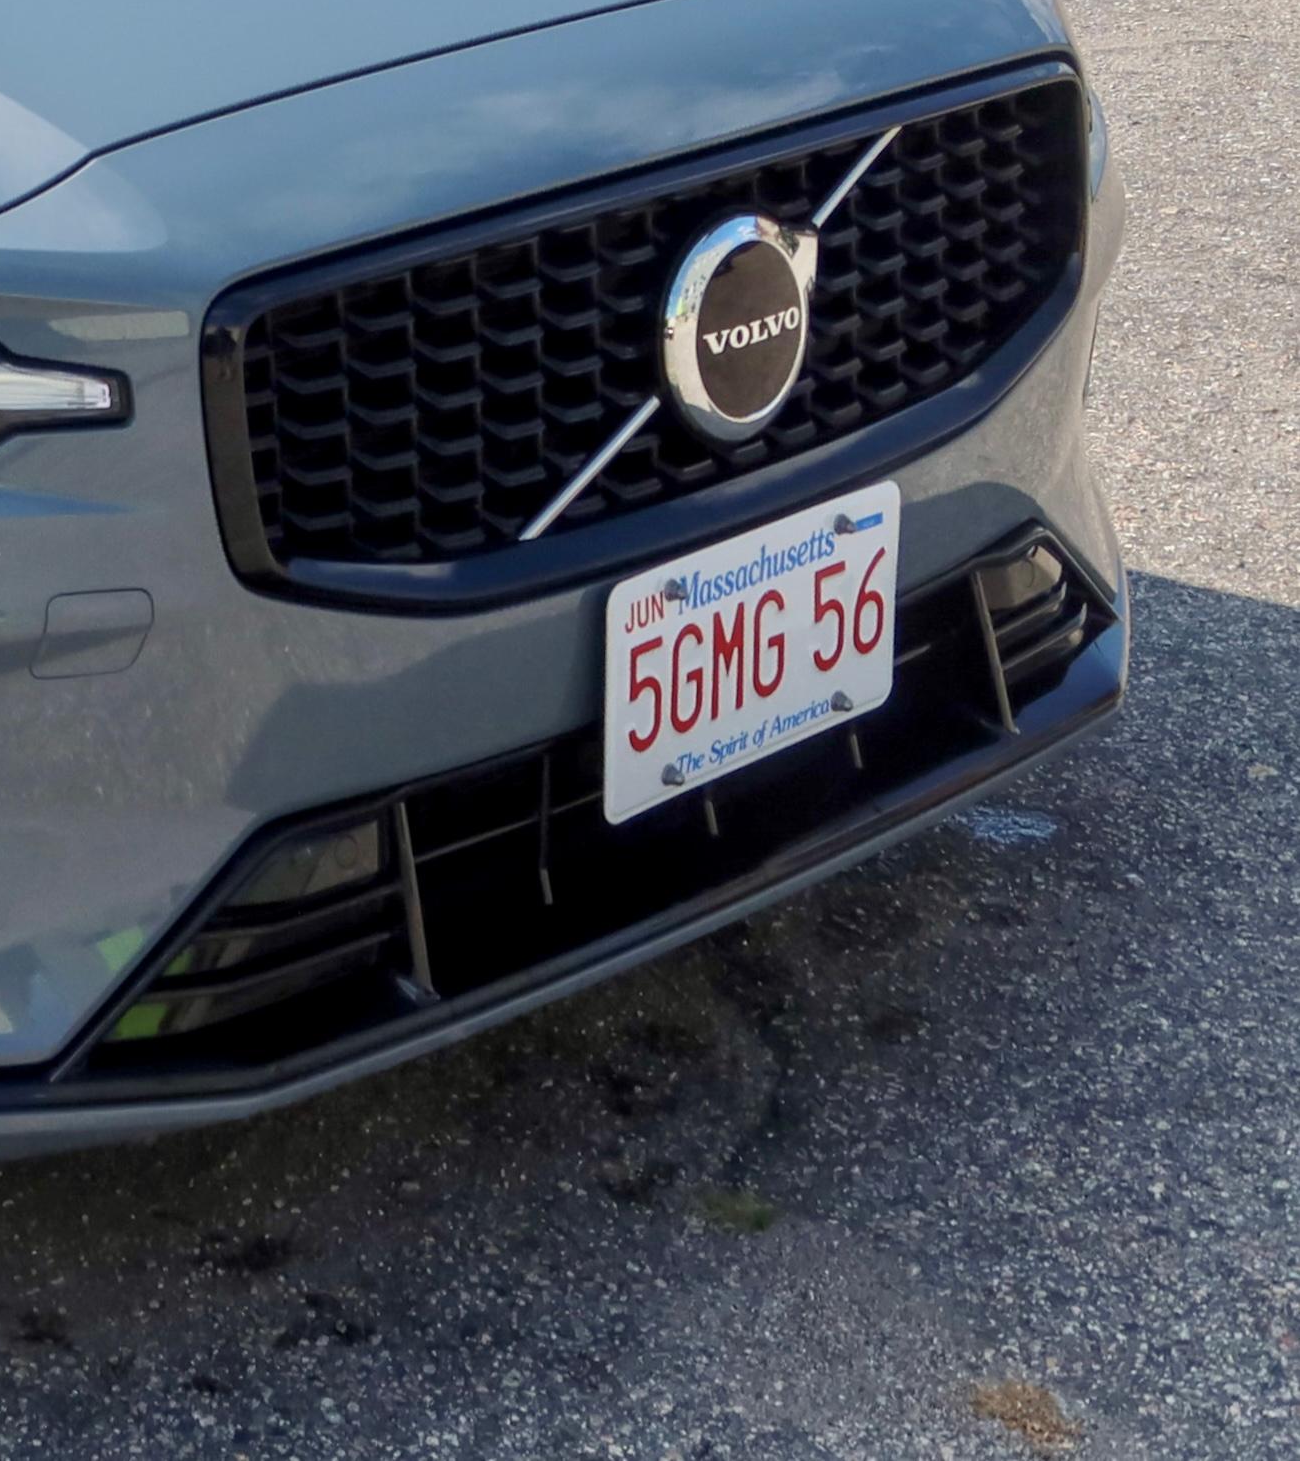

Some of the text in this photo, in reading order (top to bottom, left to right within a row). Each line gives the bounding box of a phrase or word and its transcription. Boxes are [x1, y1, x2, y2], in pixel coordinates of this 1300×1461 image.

[703, 305, 800, 355] VOLVO
[678, 529, 836, 615] Massachusetts
[625, 591, 665, 634] JUN
[628, 546, 886, 753] 5GMG 56
[675, 699, 831, 775] The Spirit of America
